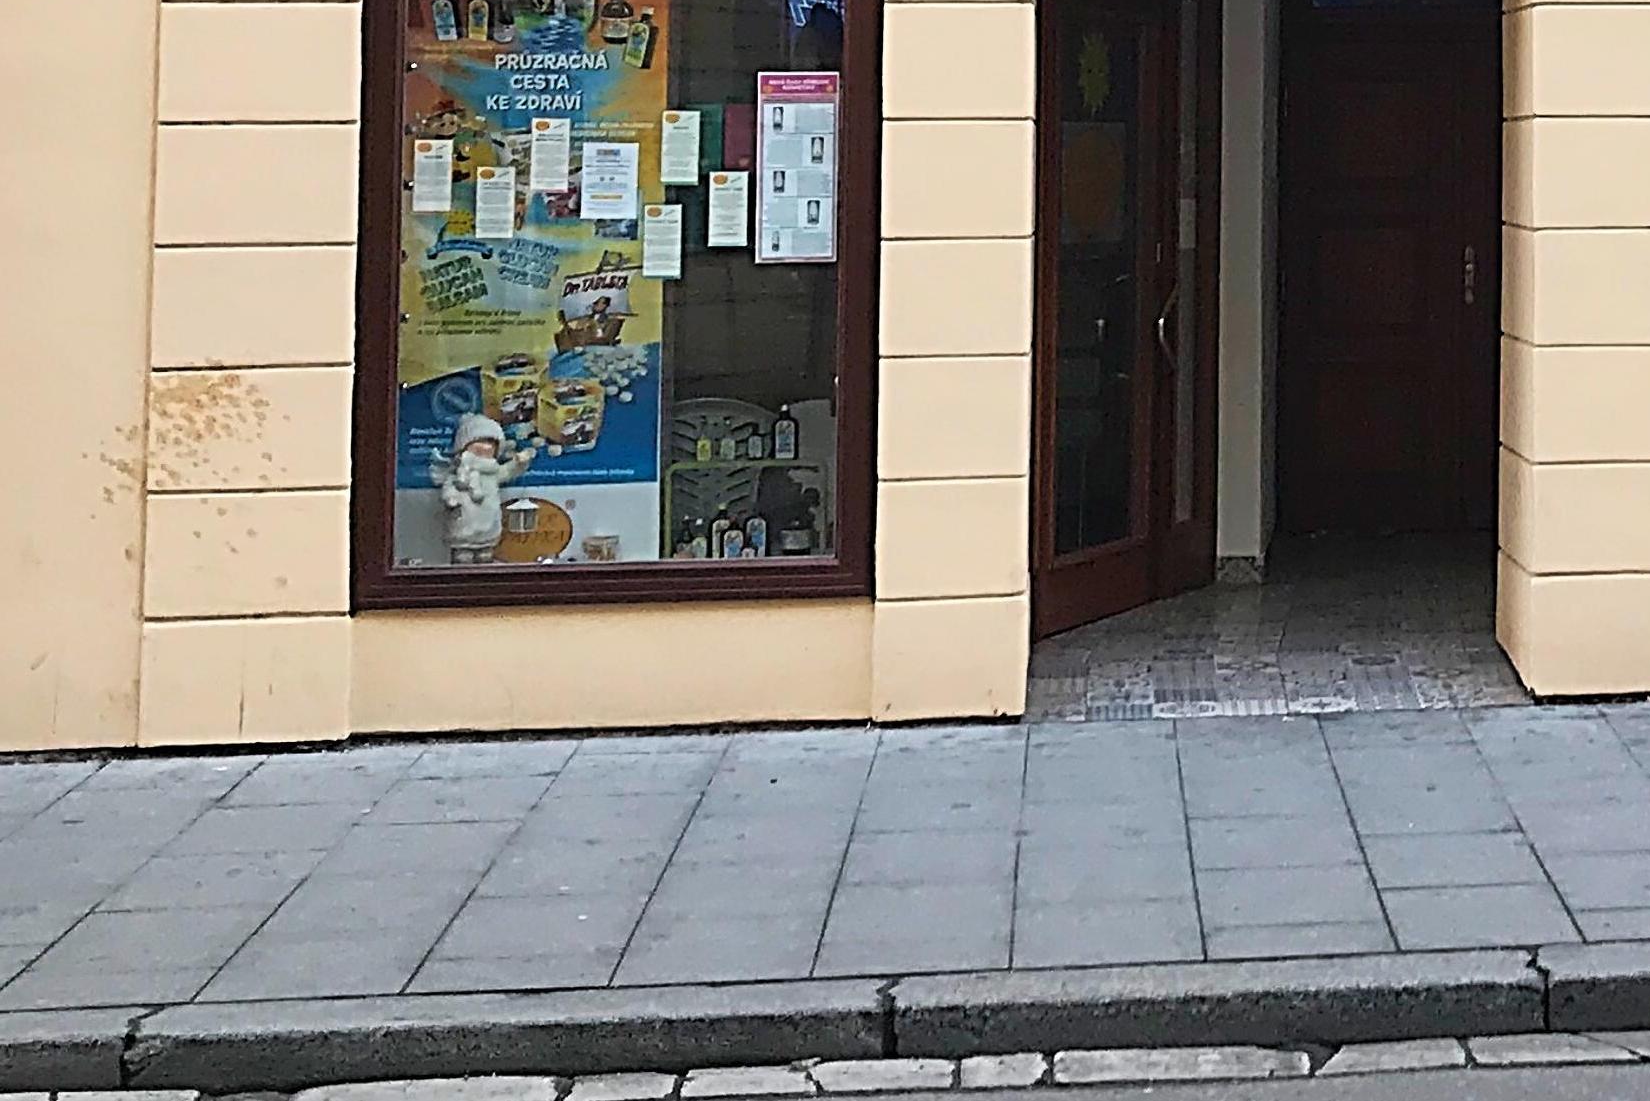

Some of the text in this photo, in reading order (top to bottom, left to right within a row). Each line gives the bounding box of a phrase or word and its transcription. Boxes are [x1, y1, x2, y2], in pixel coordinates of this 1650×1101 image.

[494, 50, 610, 71] PRŮZRAČNÁ
[510, 74, 571, 91] CESTA
[486, 90, 584, 111] KE ZDRAVÍ
